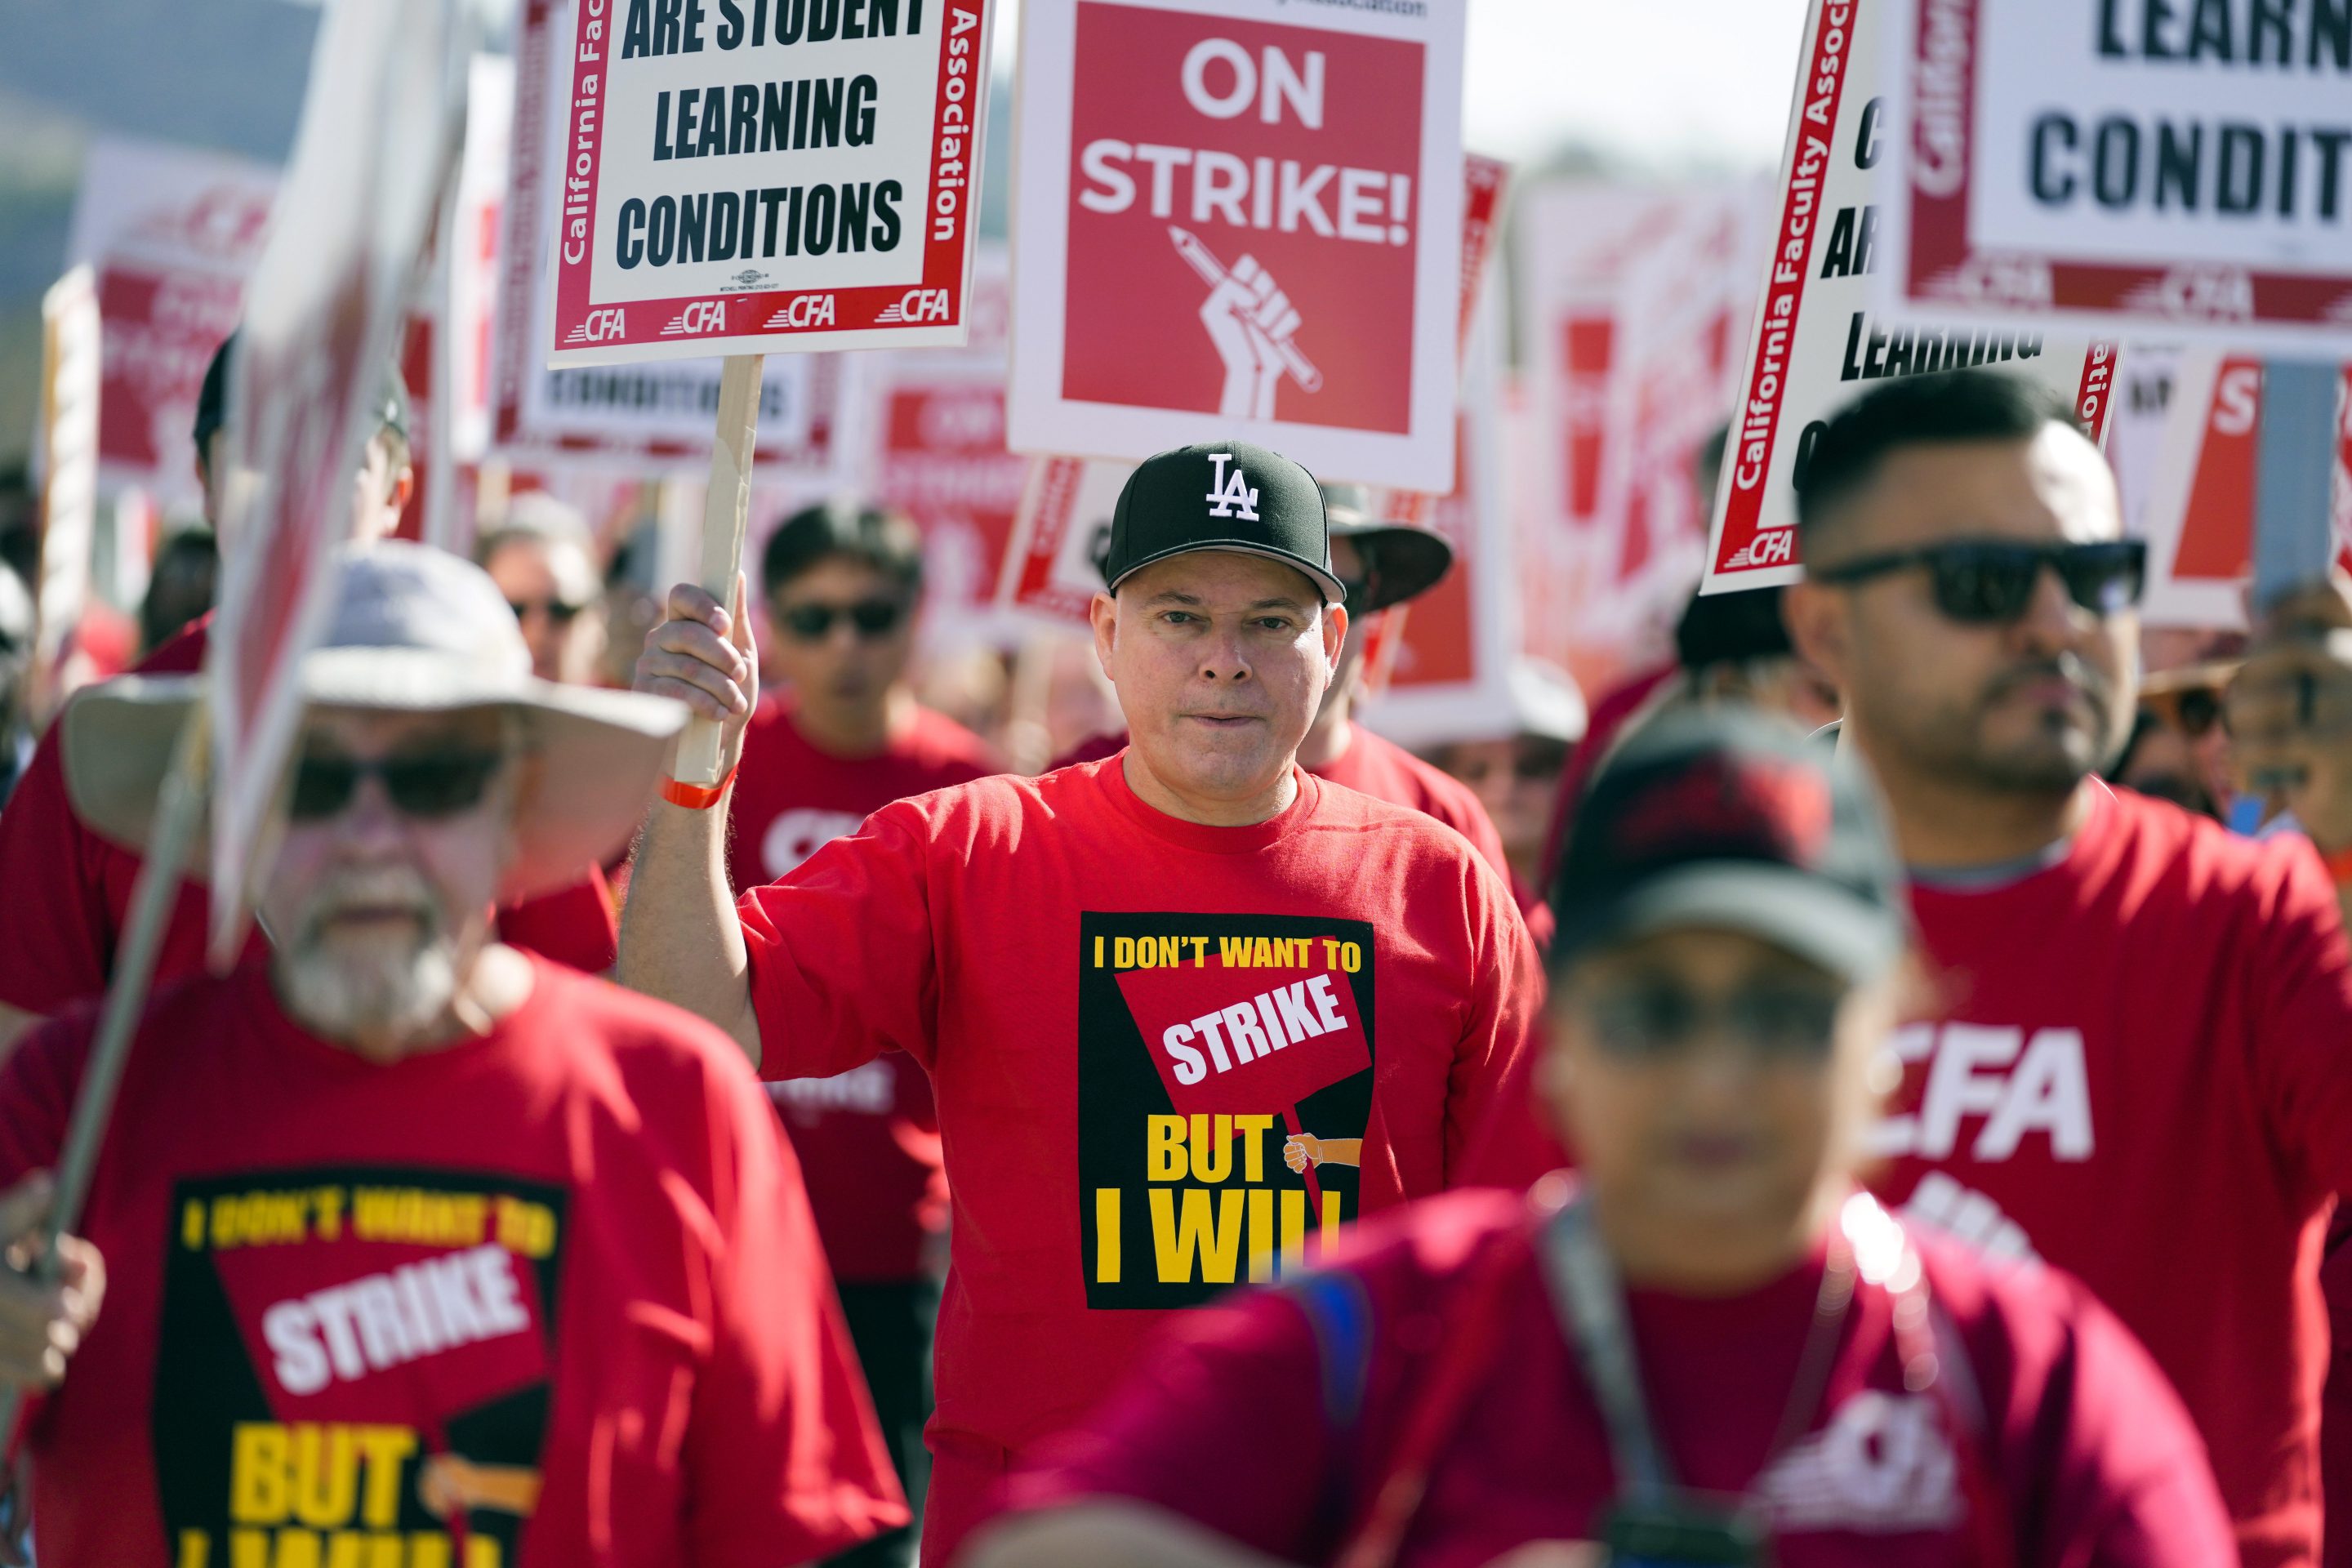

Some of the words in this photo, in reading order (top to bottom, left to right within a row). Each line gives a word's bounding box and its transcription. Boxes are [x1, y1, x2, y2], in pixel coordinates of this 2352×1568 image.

[621, 0, 706, 60] ARE
[653, 74, 878, 161] LEARNING
[933, 7, 978, 241] Association
[1181, 37, 1325, 131] ON
[564, 74, 599, 265] California
[1078, 138, 1411, 246] STRIKE!
[617, 180, 902, 270] CONDITIONS
[584, 308, 626, 342] CFA
[682, 300, 726, 334] CFA
[787, 294, 835, 327] CFA
[900, 288, 949, 323] CFA
[1737, 294, 1794, 490] California
[1775, 136, 1829, 283] Faculty
[546, 366, 789, 419] CONDITIOS
[1205, 453, 1259, 522] LA
[1748, 529, 1794, 565] CFA
[1094, 936, 1105, 969] I
[1114, 936, 1209, 969] DON'T
[1218, 936, 1313, 969] WANT
[1321, 938, 1361, 973] TO
[1162, 973, 1348, 1086] STRIKE
[1147, 1113, 1273, 1184] BUT
[1096, 1187, 1121, 1283] I
[261, 1240, 532, 1397] STRIKE
[229, 1419, 419, 1530] BUT
